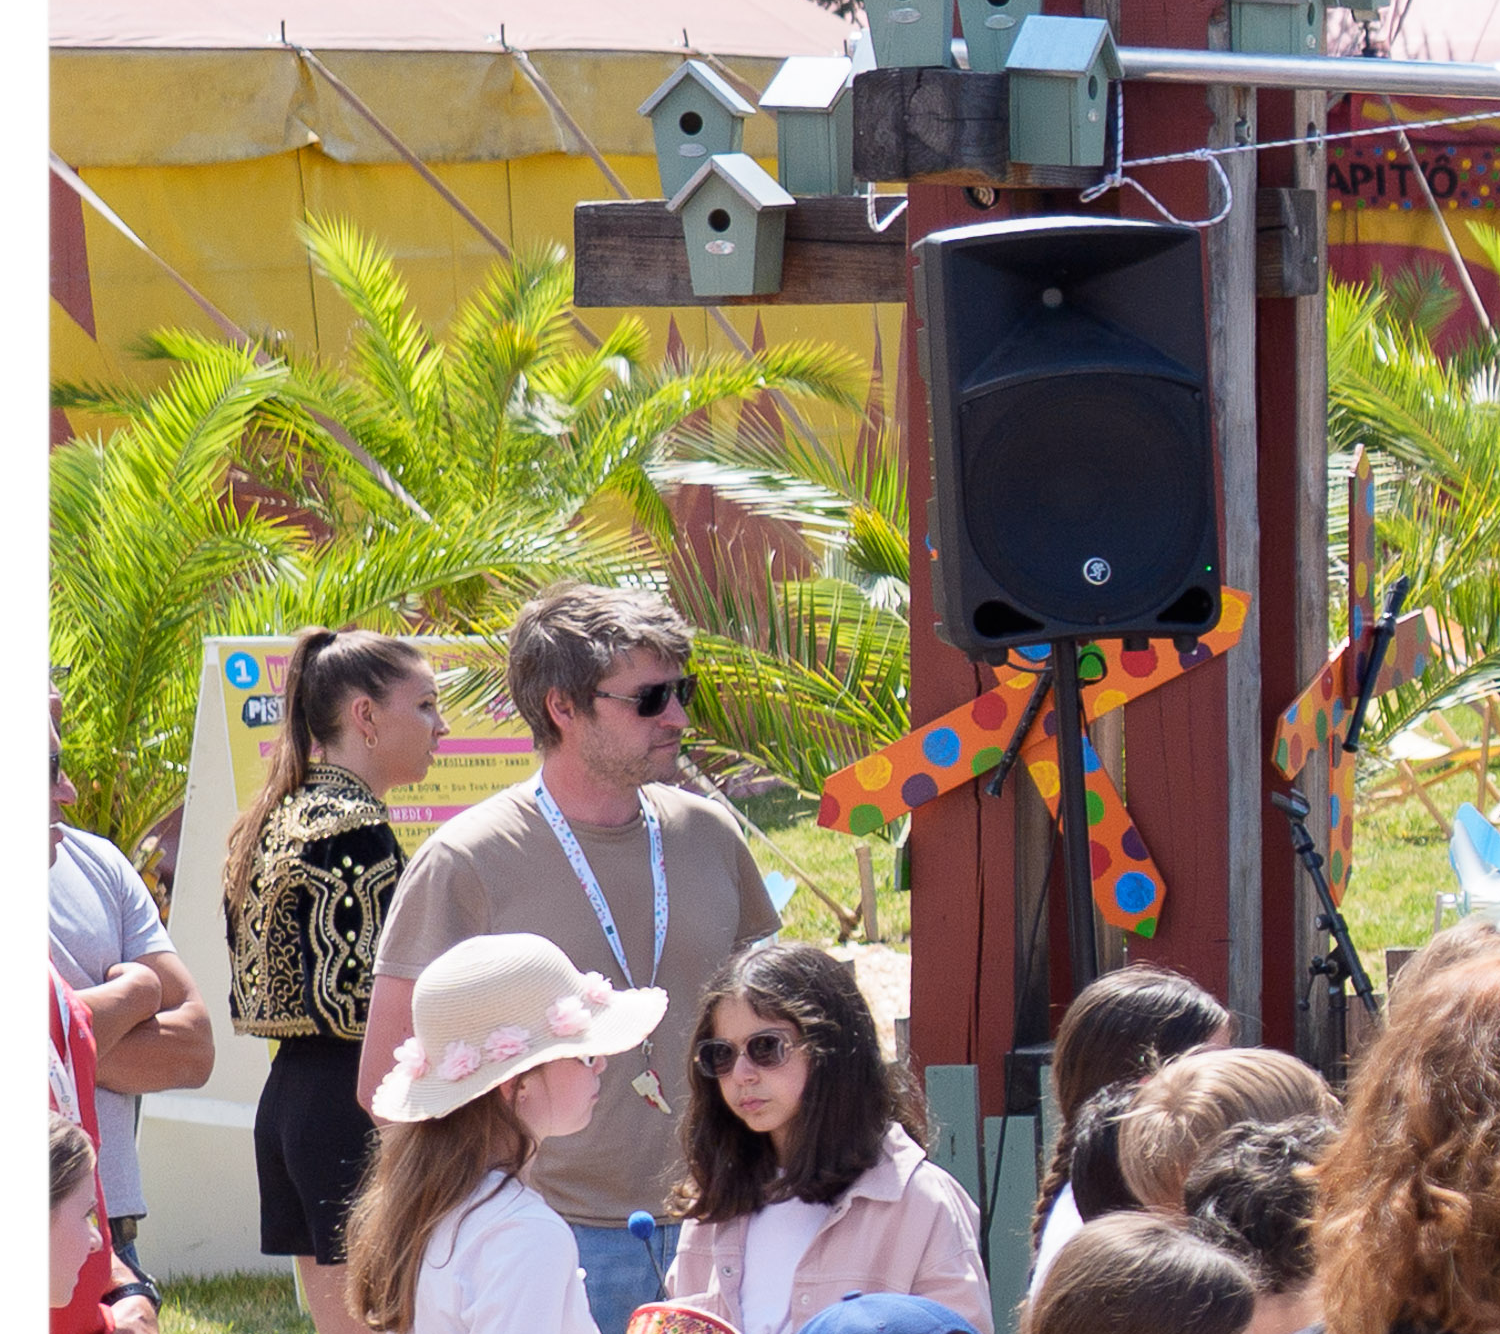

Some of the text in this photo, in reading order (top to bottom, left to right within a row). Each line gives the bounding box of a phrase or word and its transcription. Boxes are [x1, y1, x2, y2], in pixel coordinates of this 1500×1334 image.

[1327, 155, 1458, 198] APIT'Ô
[234, 659, 252, 683] 1
[390, 808, 420, 821] MEDI
